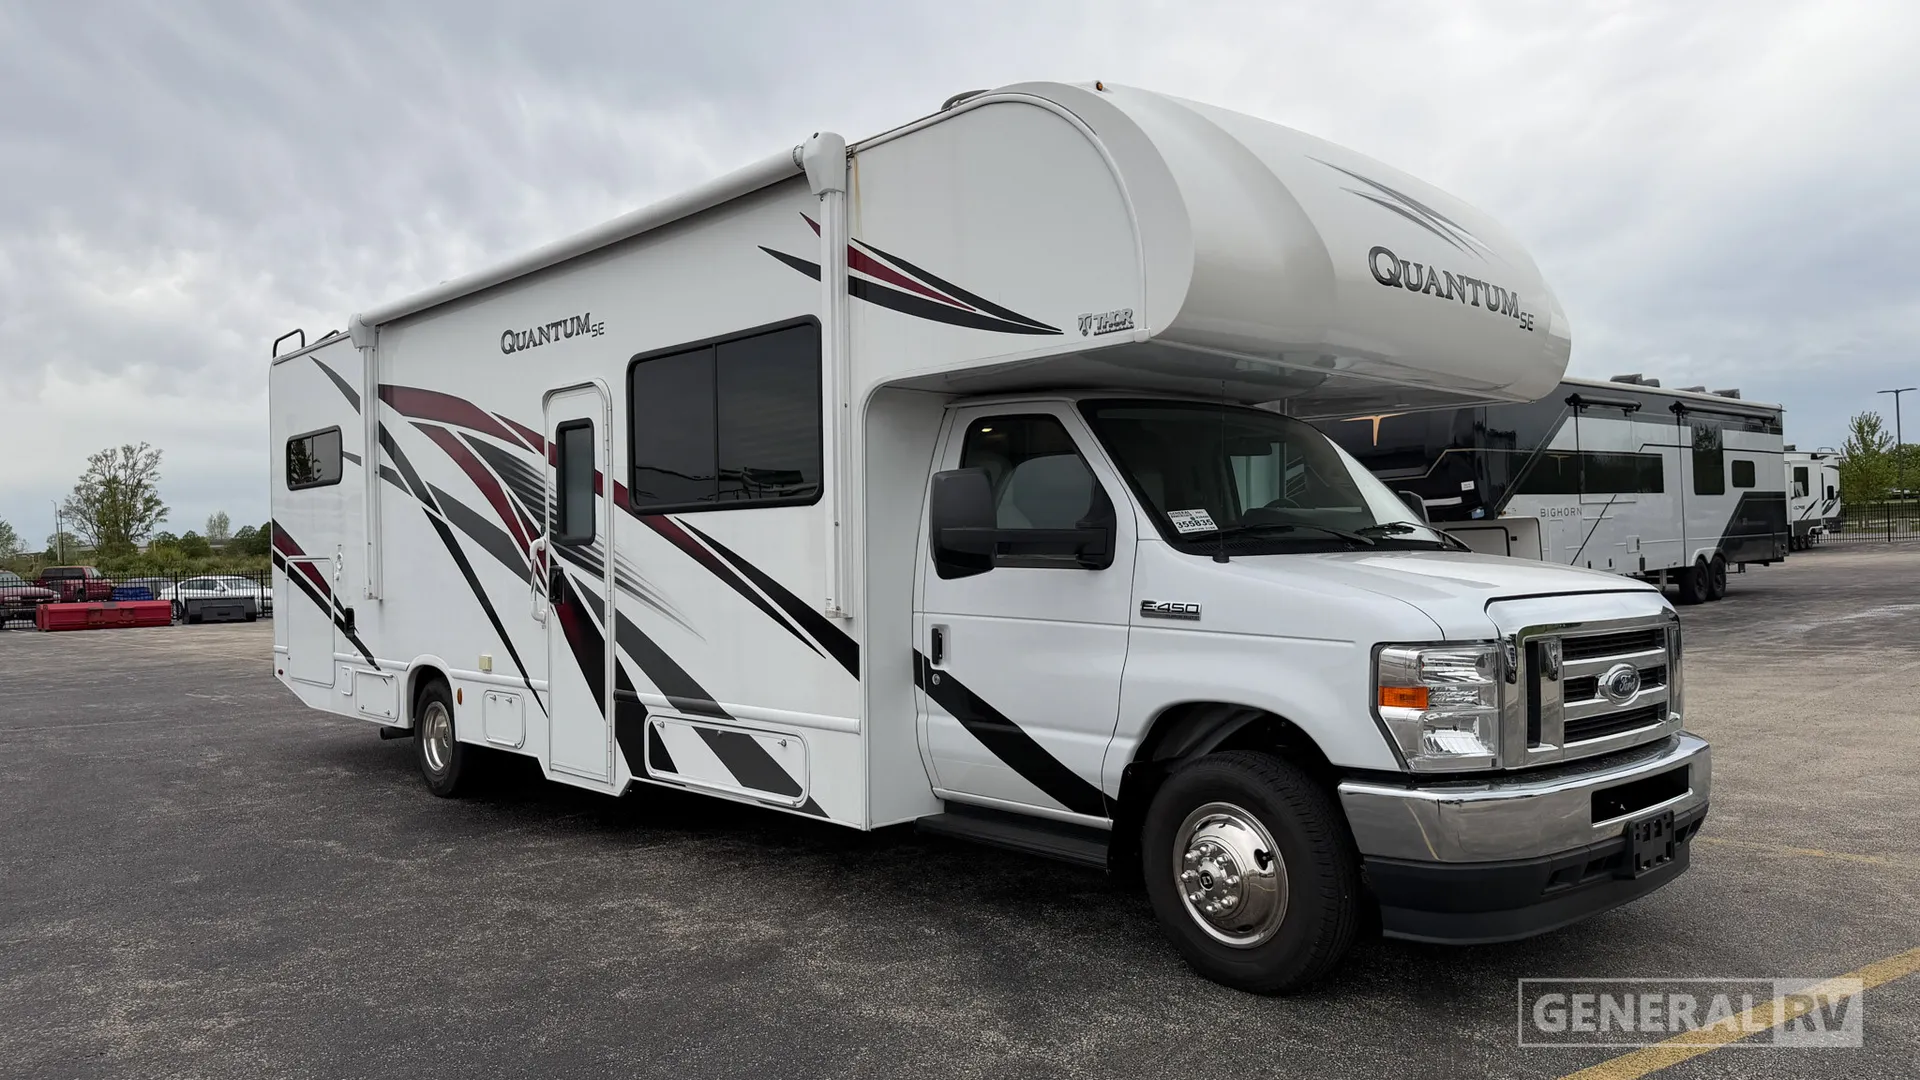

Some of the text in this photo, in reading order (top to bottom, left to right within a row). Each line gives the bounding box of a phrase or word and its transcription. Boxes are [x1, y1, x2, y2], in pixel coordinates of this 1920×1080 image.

[1368, 245, 1534, 331] QUANTUM SE
[1093, 308, 1134, 331] THOR
[500, 312, 605, 355] QUANTUM SE
[1540, 507, 1583, 518] BIGHORN
[1175, 519, 1214, 529] 355835
[1618, 674, 1637, 692] Ford
